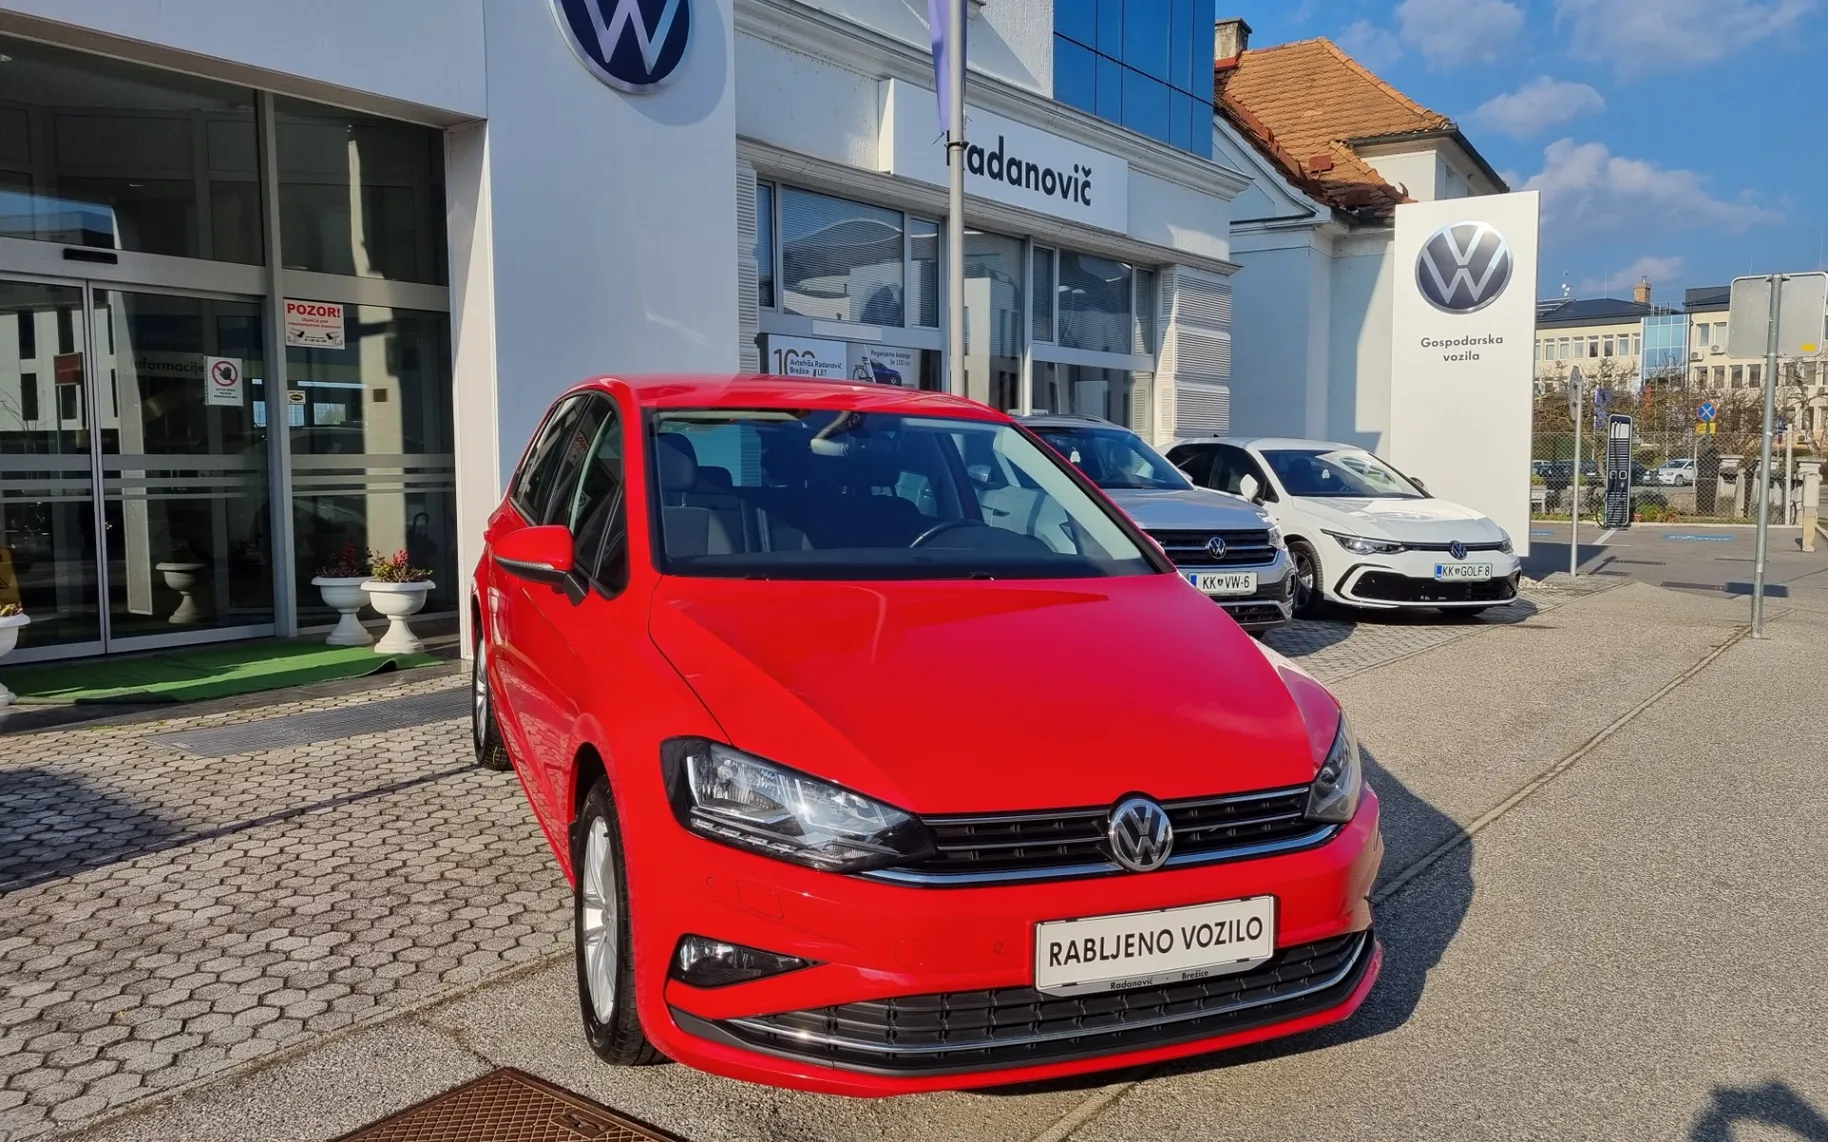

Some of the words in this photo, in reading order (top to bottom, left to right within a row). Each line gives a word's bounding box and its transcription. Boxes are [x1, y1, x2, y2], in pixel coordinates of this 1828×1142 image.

[287, 303, 340, 318] POZOR!
[1420, 334, 1503, 349] Gospodarska
[1443, 350, 1480, 362] vozila
[131, 357, 204, 375] nformacije
[789, 359, 814, 367] Avtohiša
[815, 360, 842, 369] Radanovič
[789, 367, 810, 375] Brežice
[1443, 566, 1454, 577] KK
[1460, 566, 1484, 577] GOLF
[1484, 566, 1490, 577] 8
[1203, 576, 1217, 590] KK
[1225, 576, 1250, 589] VW-6
[1049, 929, 1174, 967] RABLJENO
[1181, 916, 1263, 950] VOZILO
[1110, 976, 1153, 990] Radanovič
[1181, 969, 1209, 980] Brežice
